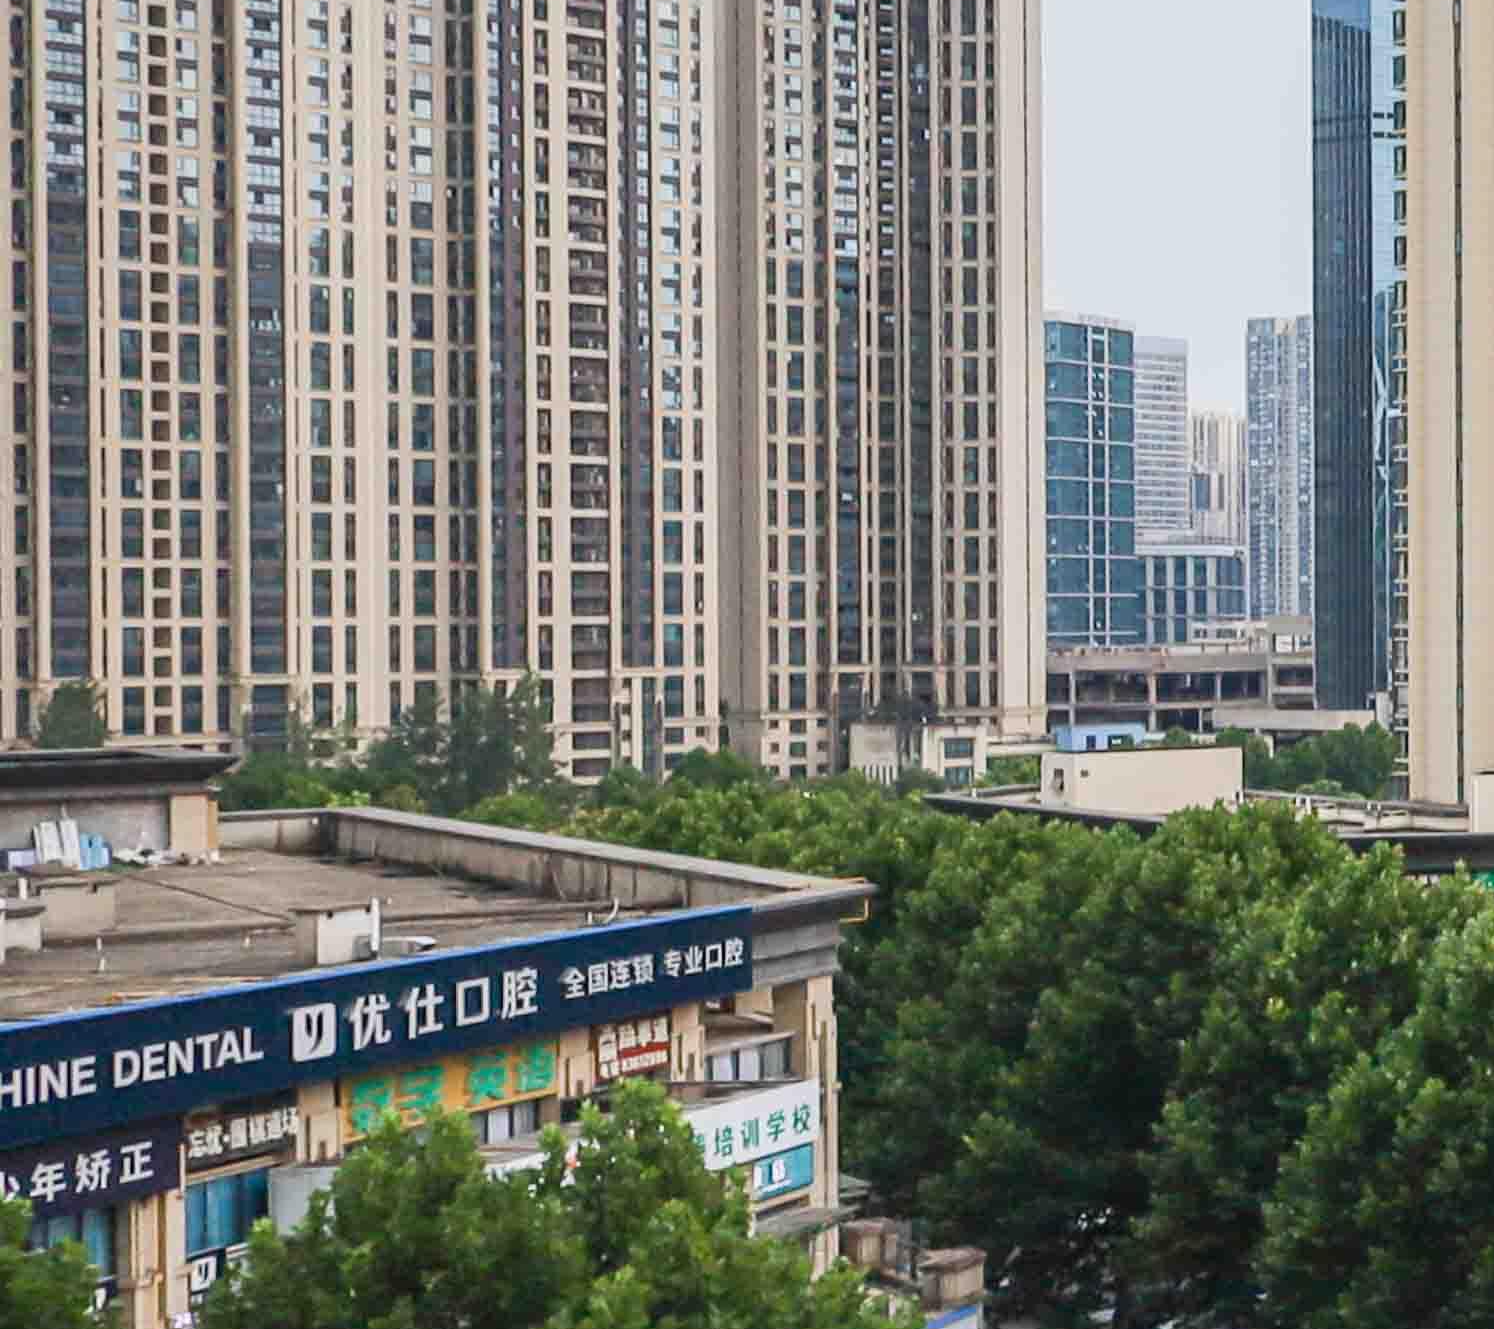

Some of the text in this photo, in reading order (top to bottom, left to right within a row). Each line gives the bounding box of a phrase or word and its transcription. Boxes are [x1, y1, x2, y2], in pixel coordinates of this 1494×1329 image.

[113, 1026, 264, 1089] DENTAL
[347, 966, 540, 1052] 优仕口腔
[561, 953, 657, 1001] 全国连锁
[662, 936, 746, 979] 专业口腔
